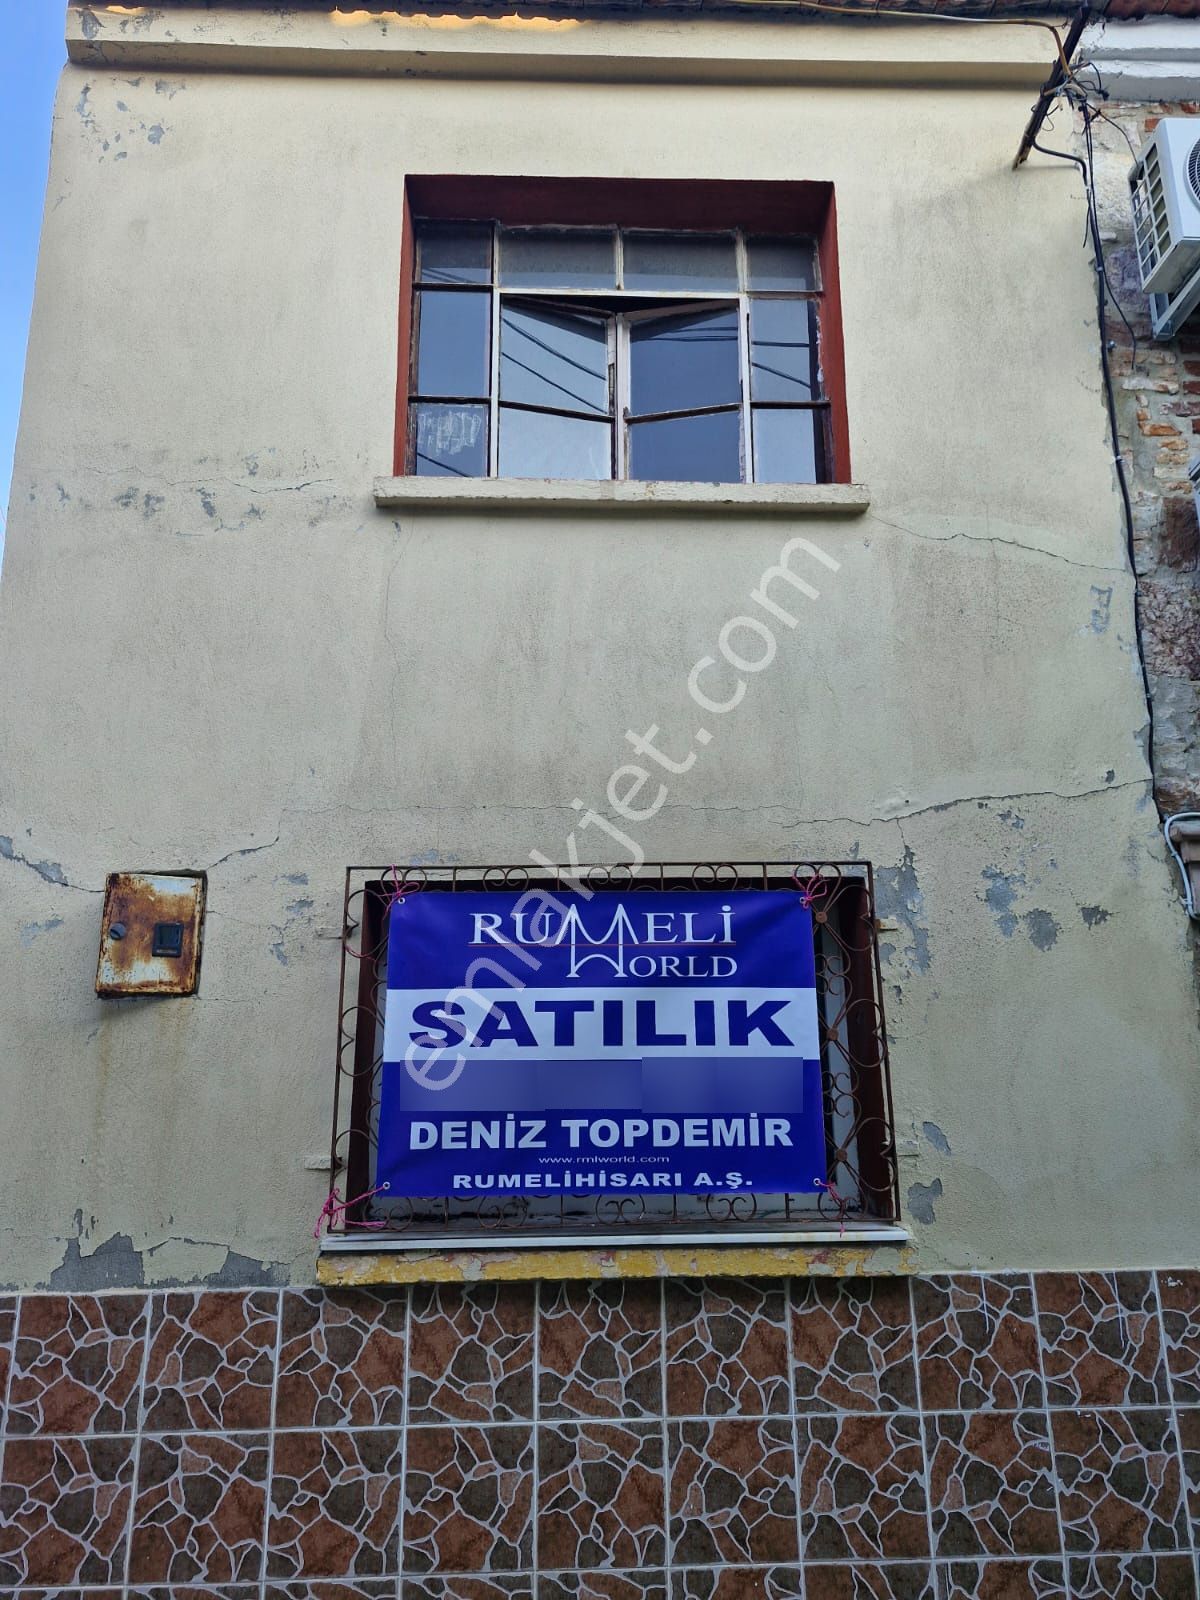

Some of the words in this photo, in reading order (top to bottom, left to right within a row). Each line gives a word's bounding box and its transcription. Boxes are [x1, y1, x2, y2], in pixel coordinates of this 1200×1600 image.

[409, 1000, 794, 1048] SATILIK
[409, 1113, 547, 1150] DENİZ
[561, 1112, 793, 1149] TOPDEMİR
[538, 1156, 670, 1164] www.rmlworld.com
[452, 1171, 683, 1189] RUMELİHİSARI
[693, 1172, 753, 1190] A.Ş.
